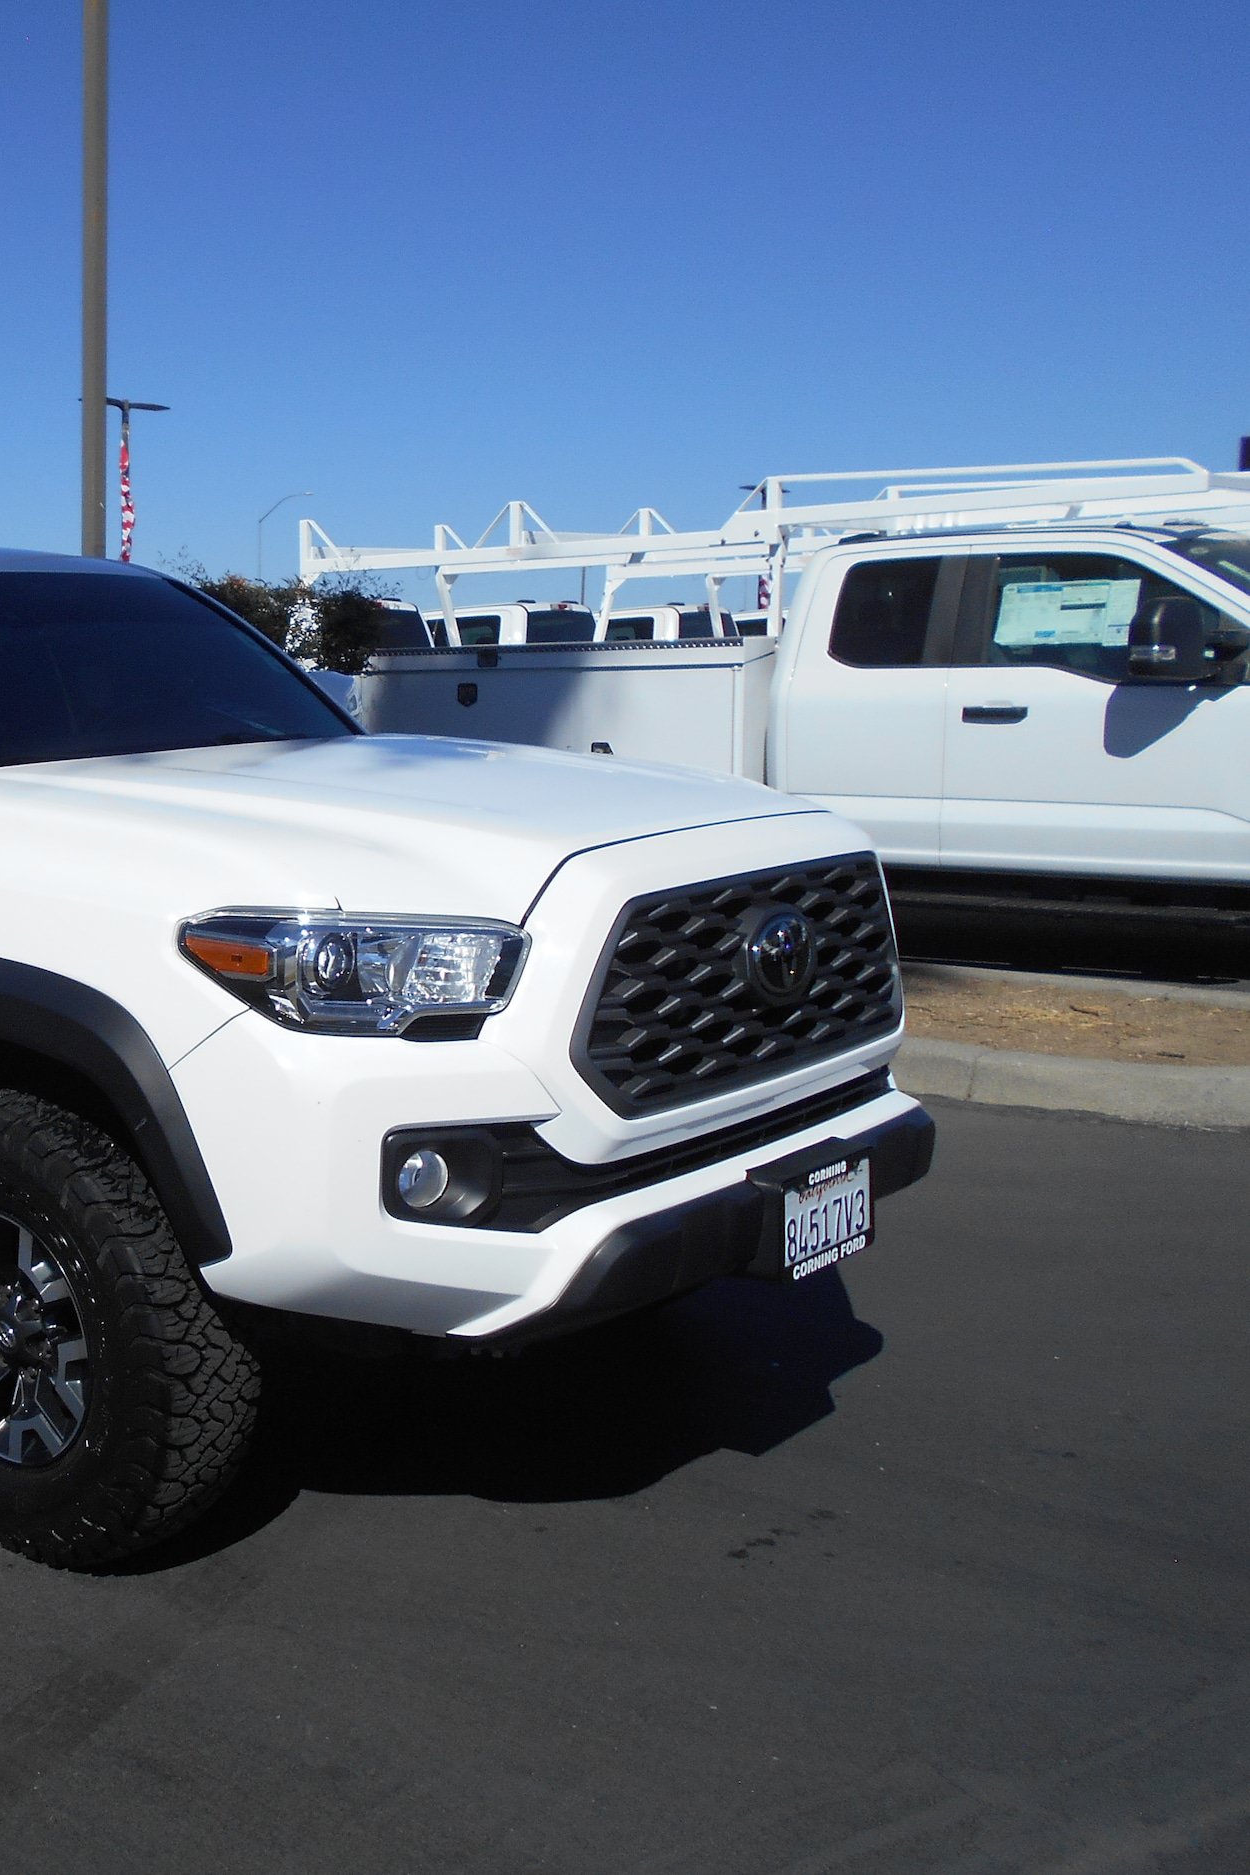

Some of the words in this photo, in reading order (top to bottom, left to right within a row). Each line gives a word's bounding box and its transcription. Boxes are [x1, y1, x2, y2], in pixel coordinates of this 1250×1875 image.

[808, 1160, 847, 1186] CORNING
[787, 1189, 865, 1262] 84517V3
[793, 1246, 839, 1280] CORNING
[840, 1234, 866, 1258] FORD
